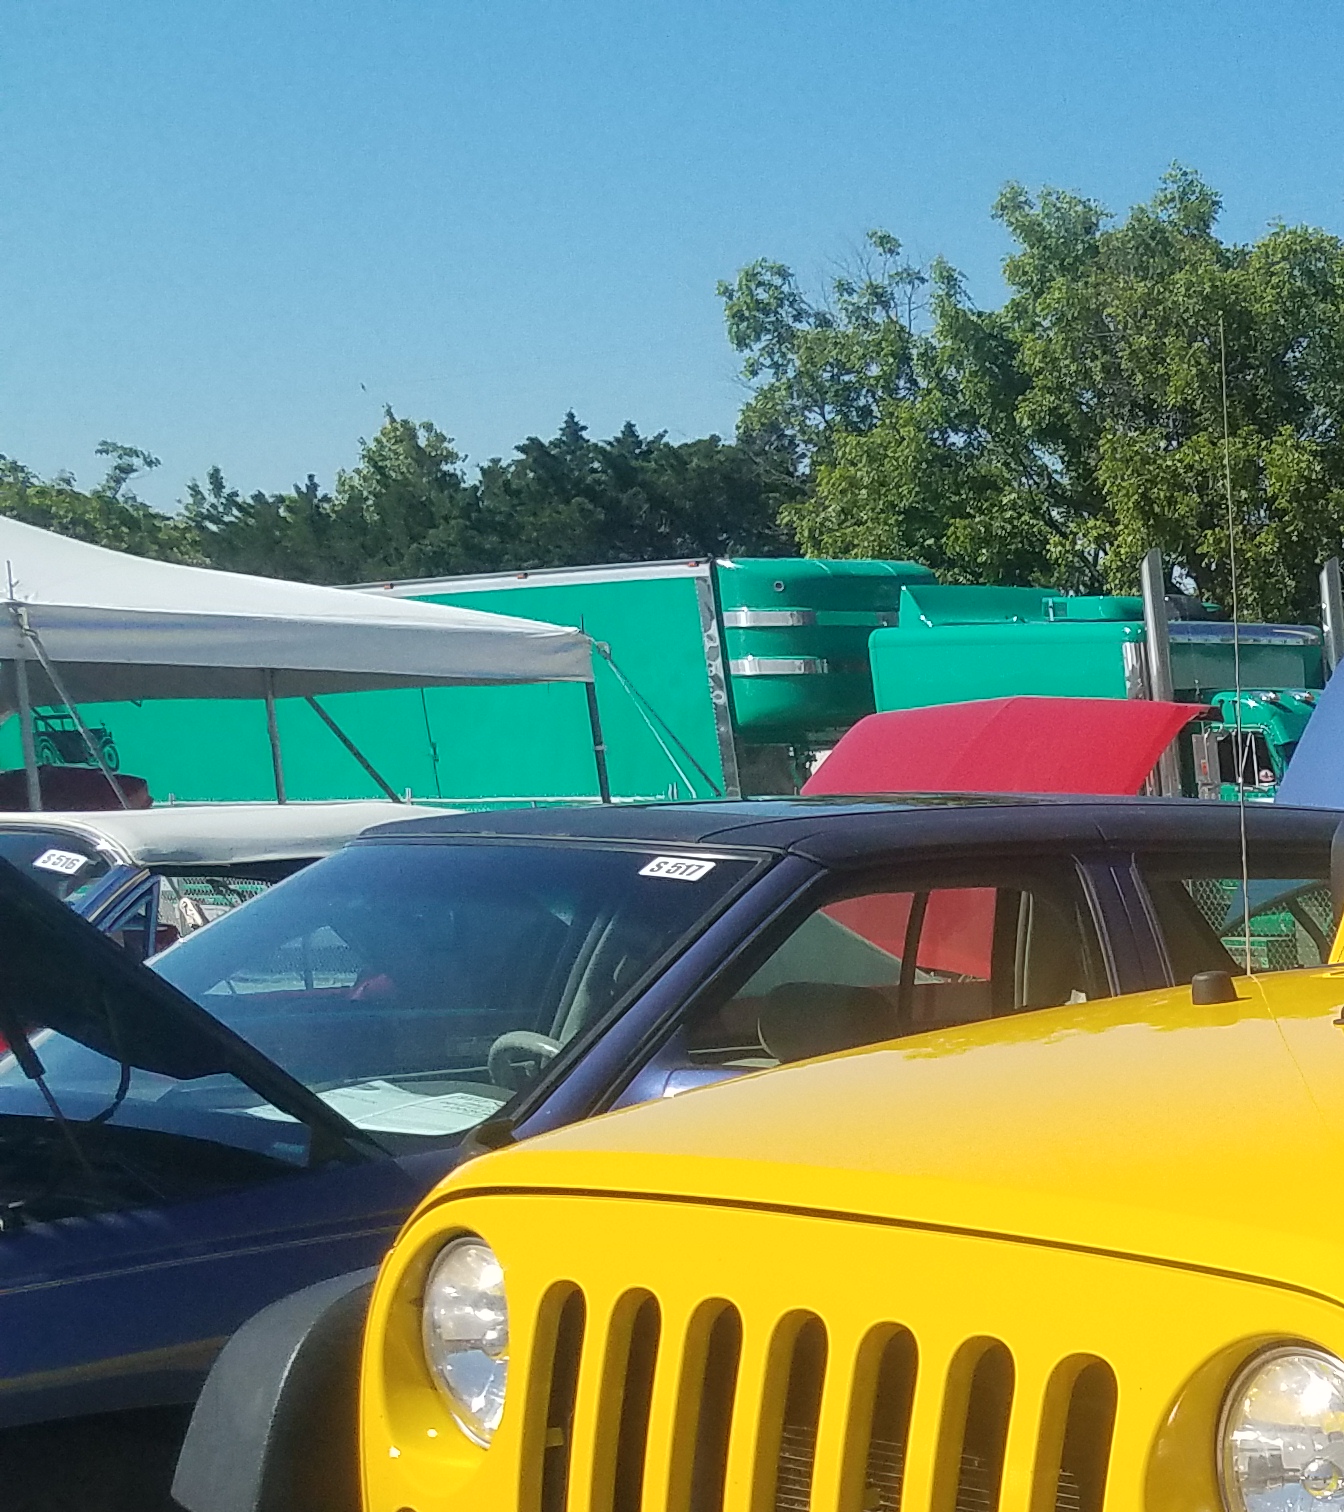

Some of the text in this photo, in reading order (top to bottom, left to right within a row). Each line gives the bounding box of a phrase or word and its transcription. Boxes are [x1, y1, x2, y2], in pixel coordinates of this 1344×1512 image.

[40, 853, 80, 870] S 516
[648, 861, 706, 877] S 517
